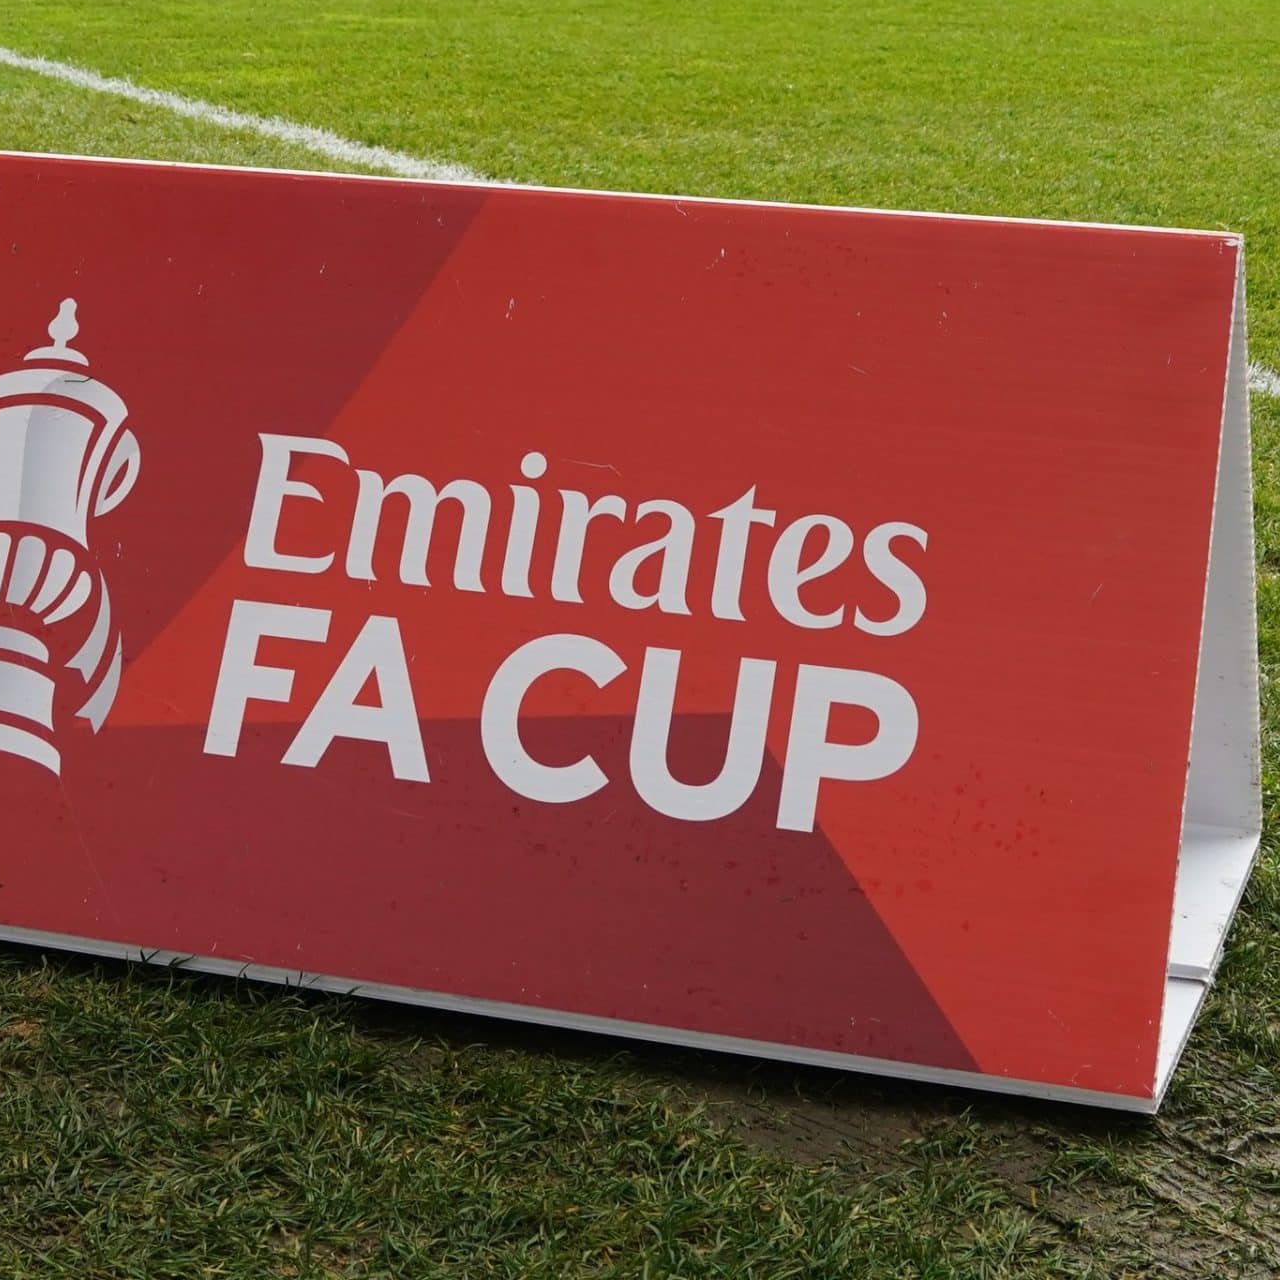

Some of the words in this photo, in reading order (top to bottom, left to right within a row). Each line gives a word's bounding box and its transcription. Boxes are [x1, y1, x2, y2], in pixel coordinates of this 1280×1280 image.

[245, 434, 928, 636] Emirates
[204, 600, 430, 783] FA
[481, 634, 918, 832] CUP
